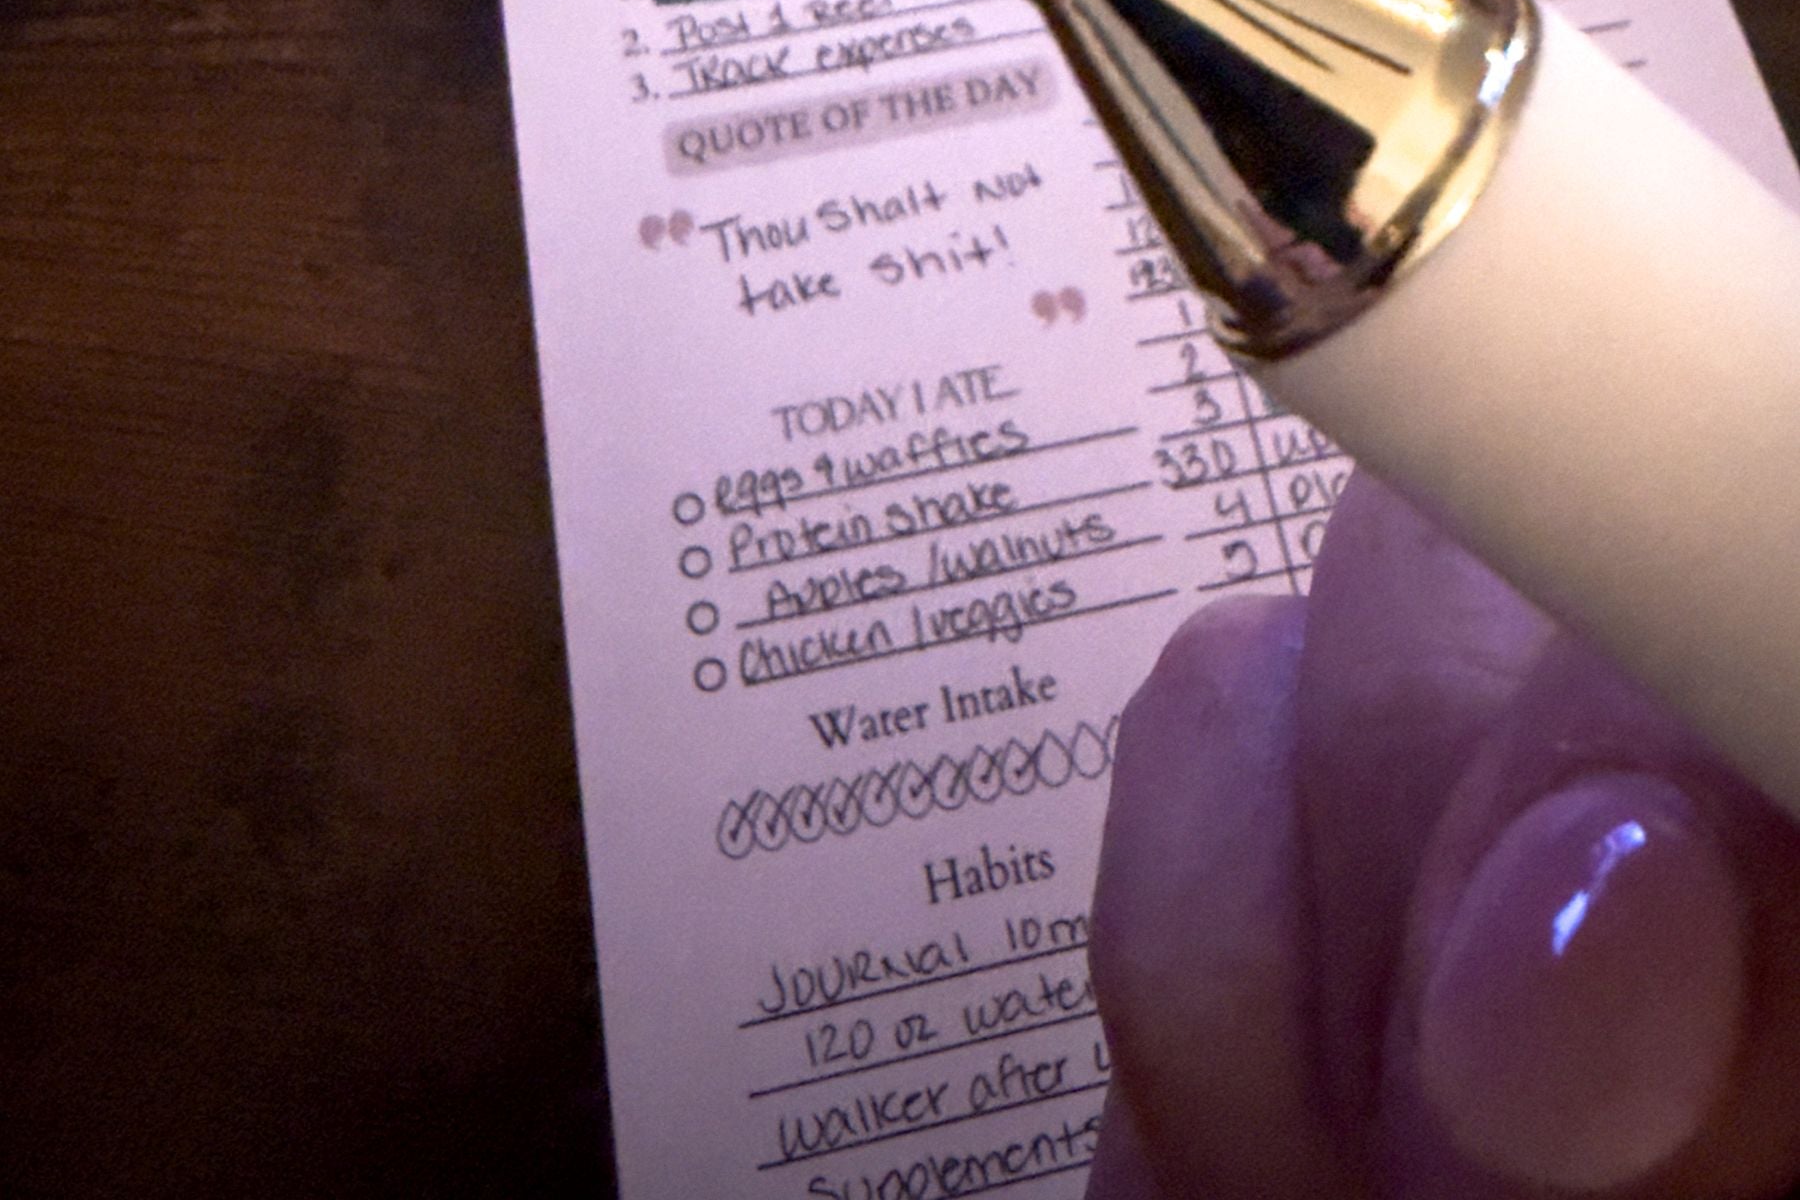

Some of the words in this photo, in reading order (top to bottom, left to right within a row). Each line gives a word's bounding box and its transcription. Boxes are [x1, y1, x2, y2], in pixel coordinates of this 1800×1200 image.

[677, 112, 813, 165] QUOTE
[821, 100, 873, 132] OF
[887, 81, 957, 118] THE
[964, 65, 1042, 106] DAY
[700, 214, 810, 263] Thou
[738, 271, 842, 316] take
[773, 388, 903, 442] TODAY
[936, 365, 1018, 406] ATE
[1194, 386, 1222, 425] 3
[714, 468, 802, 518] eggs
[1214, 489, 1254, 524] 4
[809, 702, 930, 749] Water
[939, 665, 1058, 722] Intake
[924, 844, 1057, 904] Habits
[804, 1018, 876, 1067] 120
[777, 1085, 950, 1162] walker
[969, 1053, 1068, 1113] after
